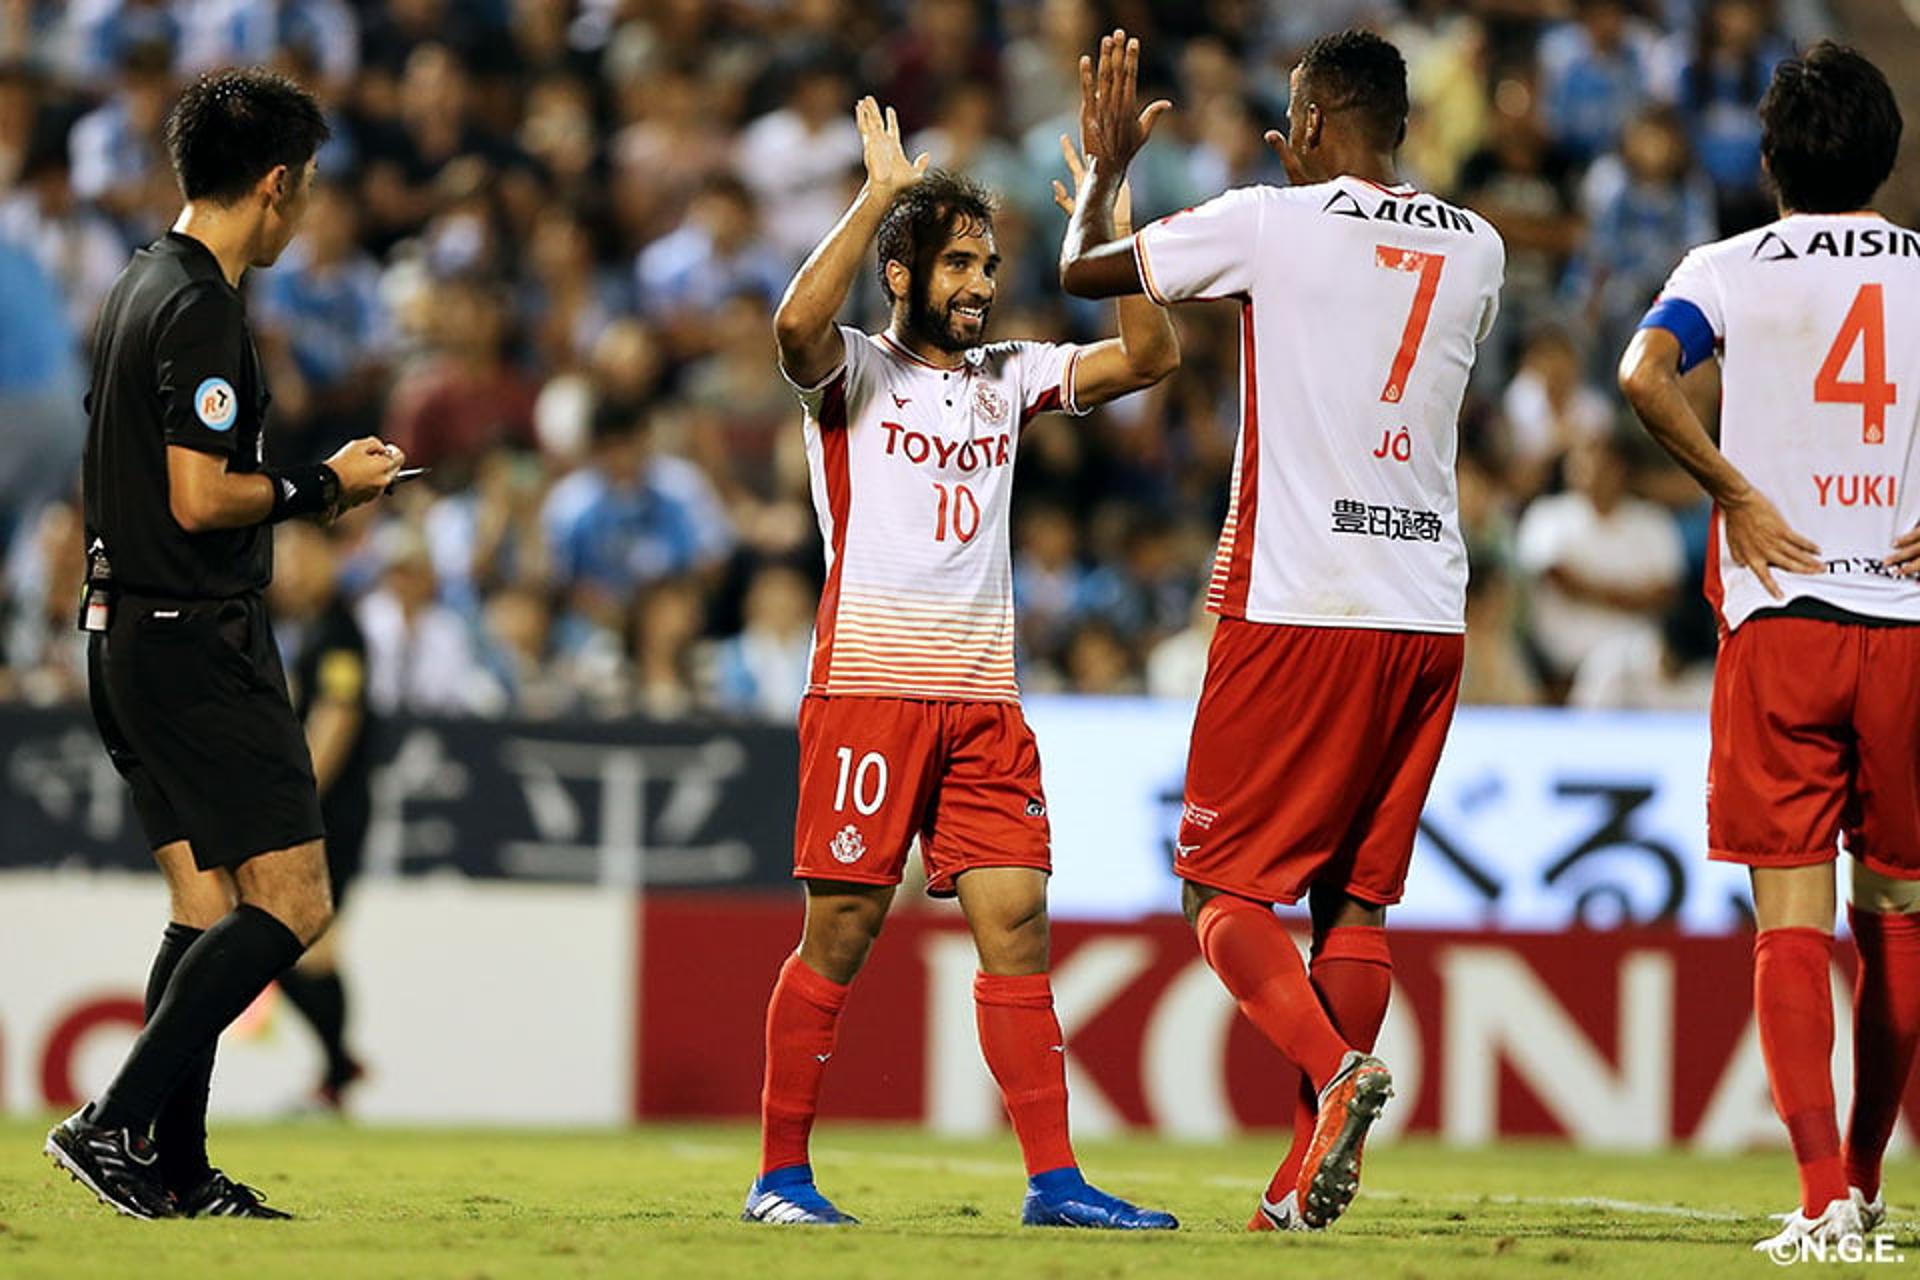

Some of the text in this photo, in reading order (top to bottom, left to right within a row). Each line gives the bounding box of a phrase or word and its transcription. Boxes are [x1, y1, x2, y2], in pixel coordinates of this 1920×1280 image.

[1373, 199, 1475, 235] AISIN
[1375, 244, 1446, 404] 7
[1813, 283, 1897, 444] 4
[881, 421, 1010, 472] TOYOTA
[1373, 425, 1412, 462] JÔ
[933, 482, 980, 544] 10
[1812, 473, 1897, 507] YUKI
[833, 746, 888, 816] 10
